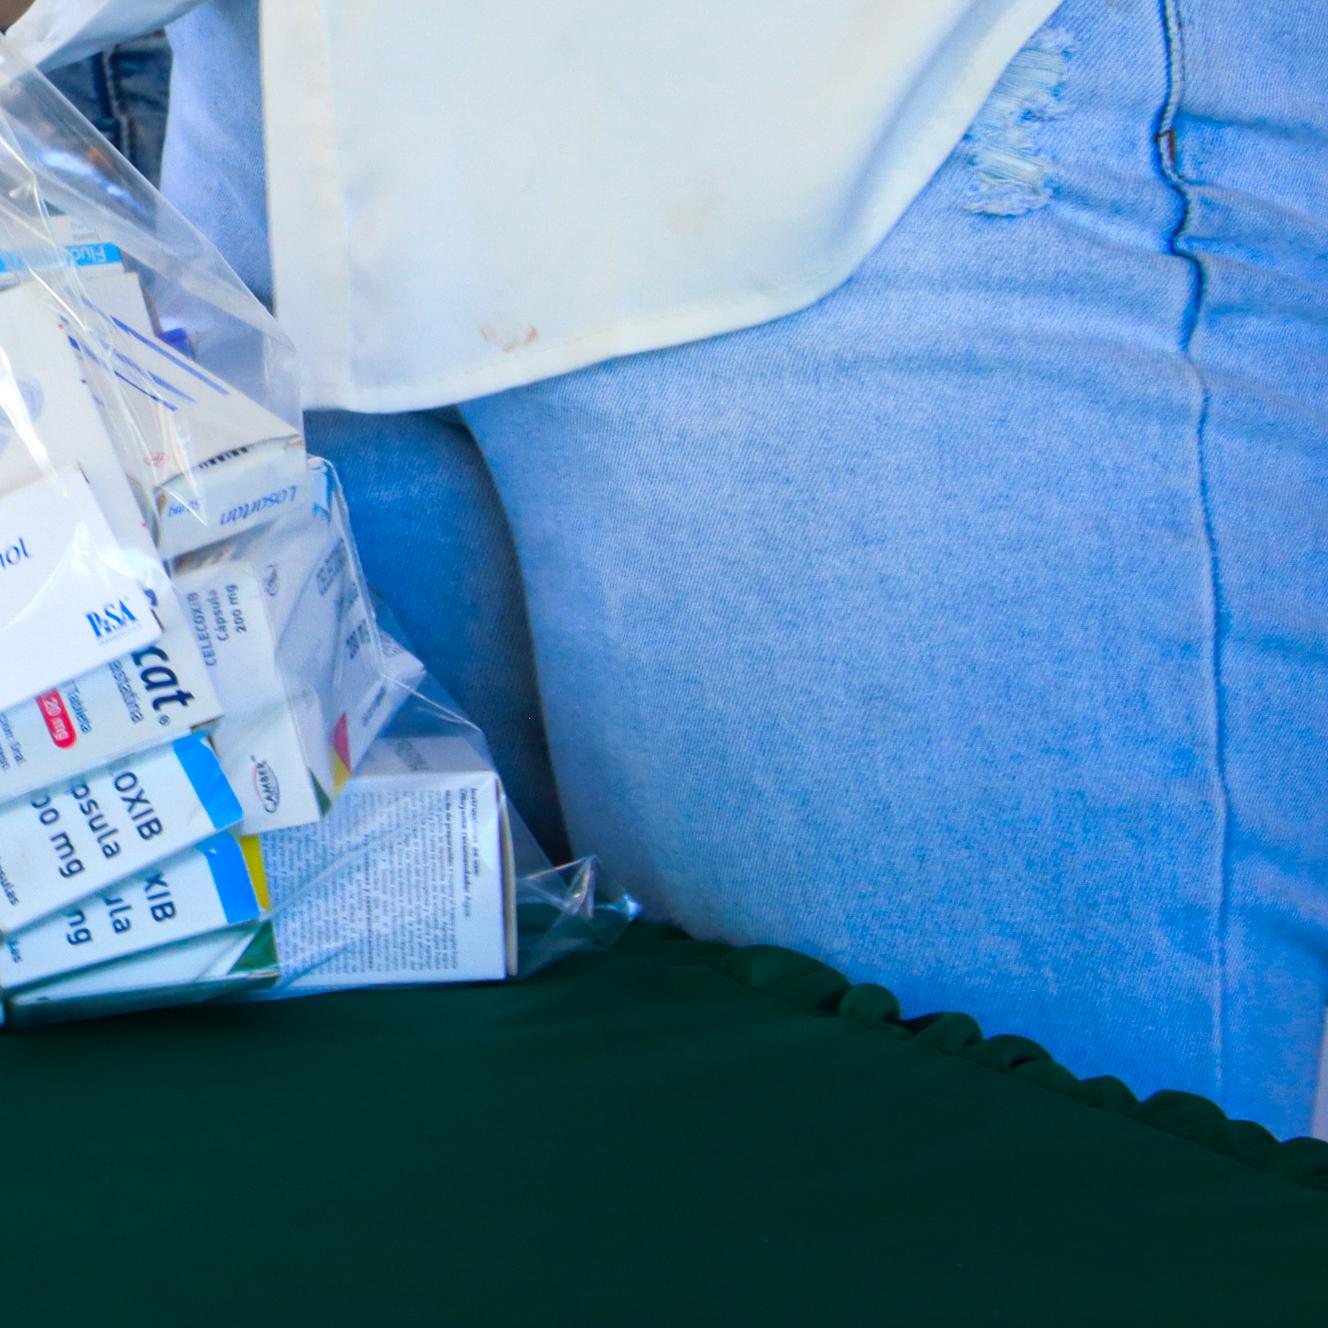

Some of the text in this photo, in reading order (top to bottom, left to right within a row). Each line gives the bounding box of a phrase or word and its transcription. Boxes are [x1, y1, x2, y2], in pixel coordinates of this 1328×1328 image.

[186, 590, 218, 668] CELECOXIB
[225, 583, 248, 634] 200 mg
[44, 697, 62, 717] 20
[71, 782, 123, 860] psula
[113, 770, 165, 842] OXIB
[49, 830, 86, 880] mg
